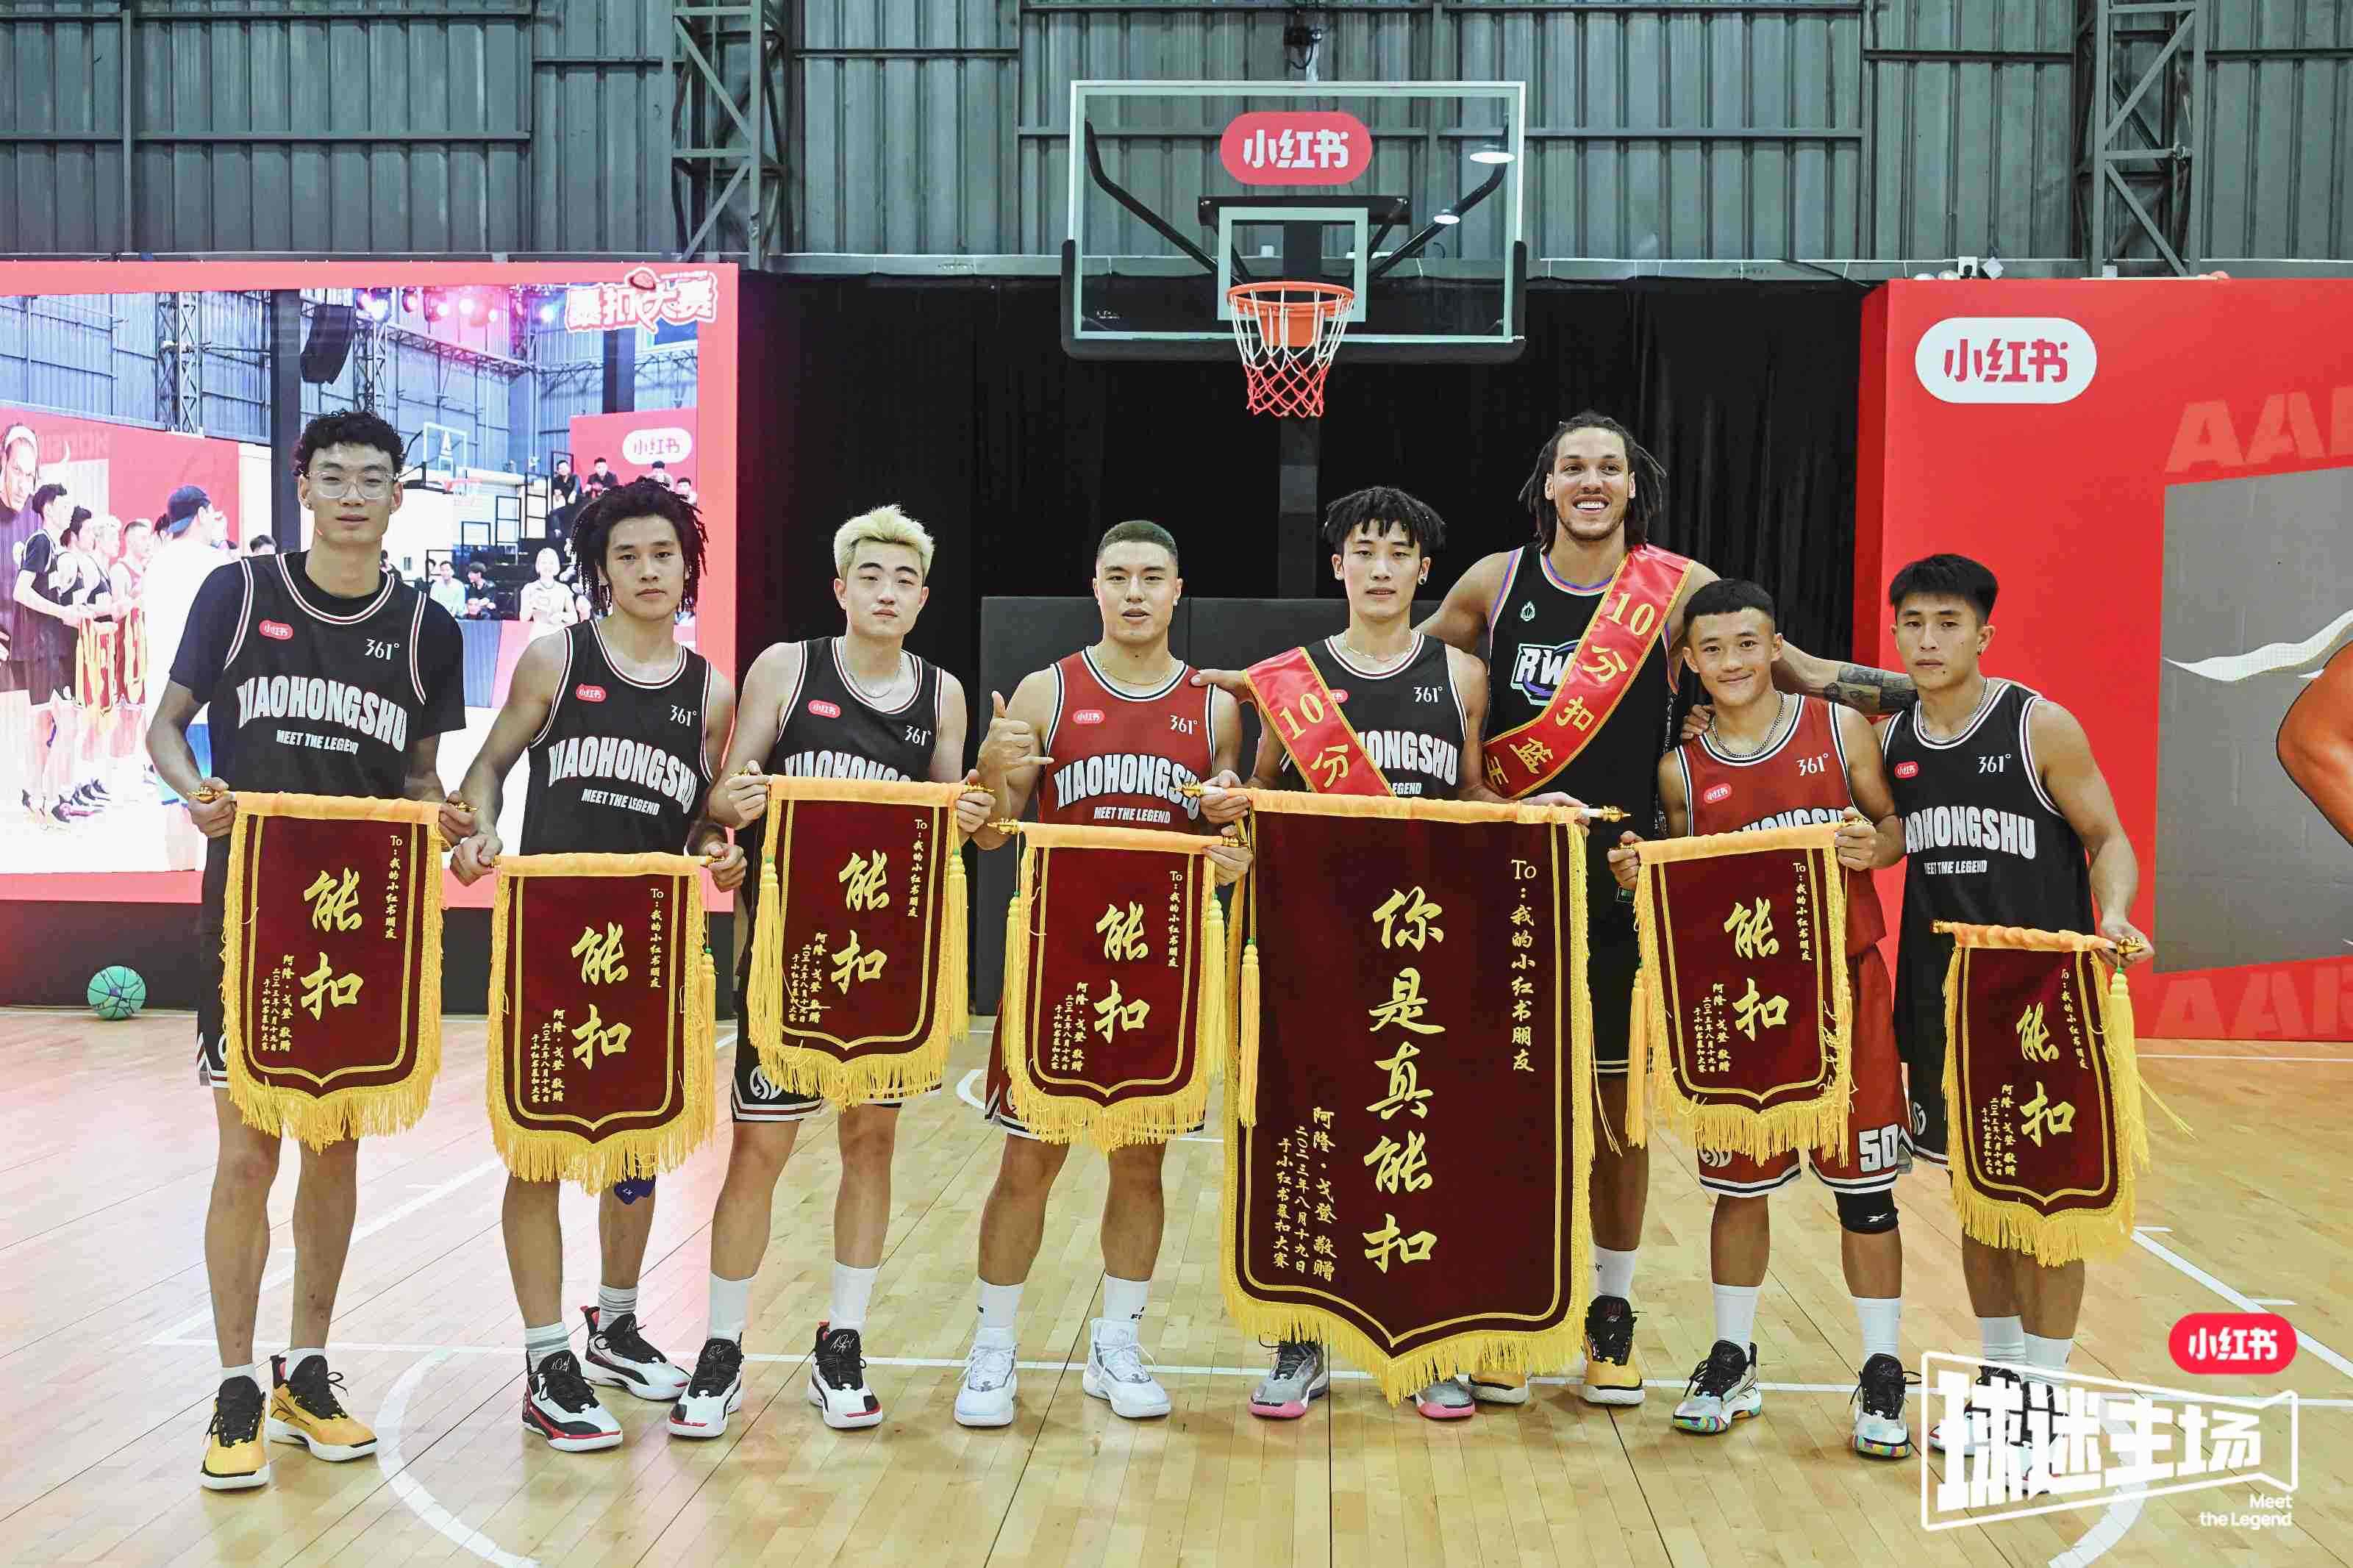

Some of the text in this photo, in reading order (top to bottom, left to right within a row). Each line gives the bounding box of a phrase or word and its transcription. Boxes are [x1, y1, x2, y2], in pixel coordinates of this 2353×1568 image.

[1243, 129, 1349, 168] 小红书
[1944, 339, 2068, 382] 小红书
[276, 729, 304, 745] MEET
[304, 733, 324, 748] THE
[1358, 731, 1458, 785] ONGSHU
[581, 788, 660, 815] MEET THE LEGEND
[1093, 806, 1171, 824] MEET THE LEGEND
[1954, 860, 1988, 873] LEGEND
[300, 867, 364, 1020] 能扣
[830, 849, 890, 995] 能扣
[1511, 859, 1537, 1073] To：我的小红书朋友
[1724, 896, 1789, 1042] 能扣
[571, 921, 632, 1070] 能扣
[1093, 901, 1151, 1044] 能扣
[1363, 886, 1446, 1275] 你是真能扣
[2016, 1001, 2076, 1148] 能扣
[1859, 1124, 1899, 1173] 50
